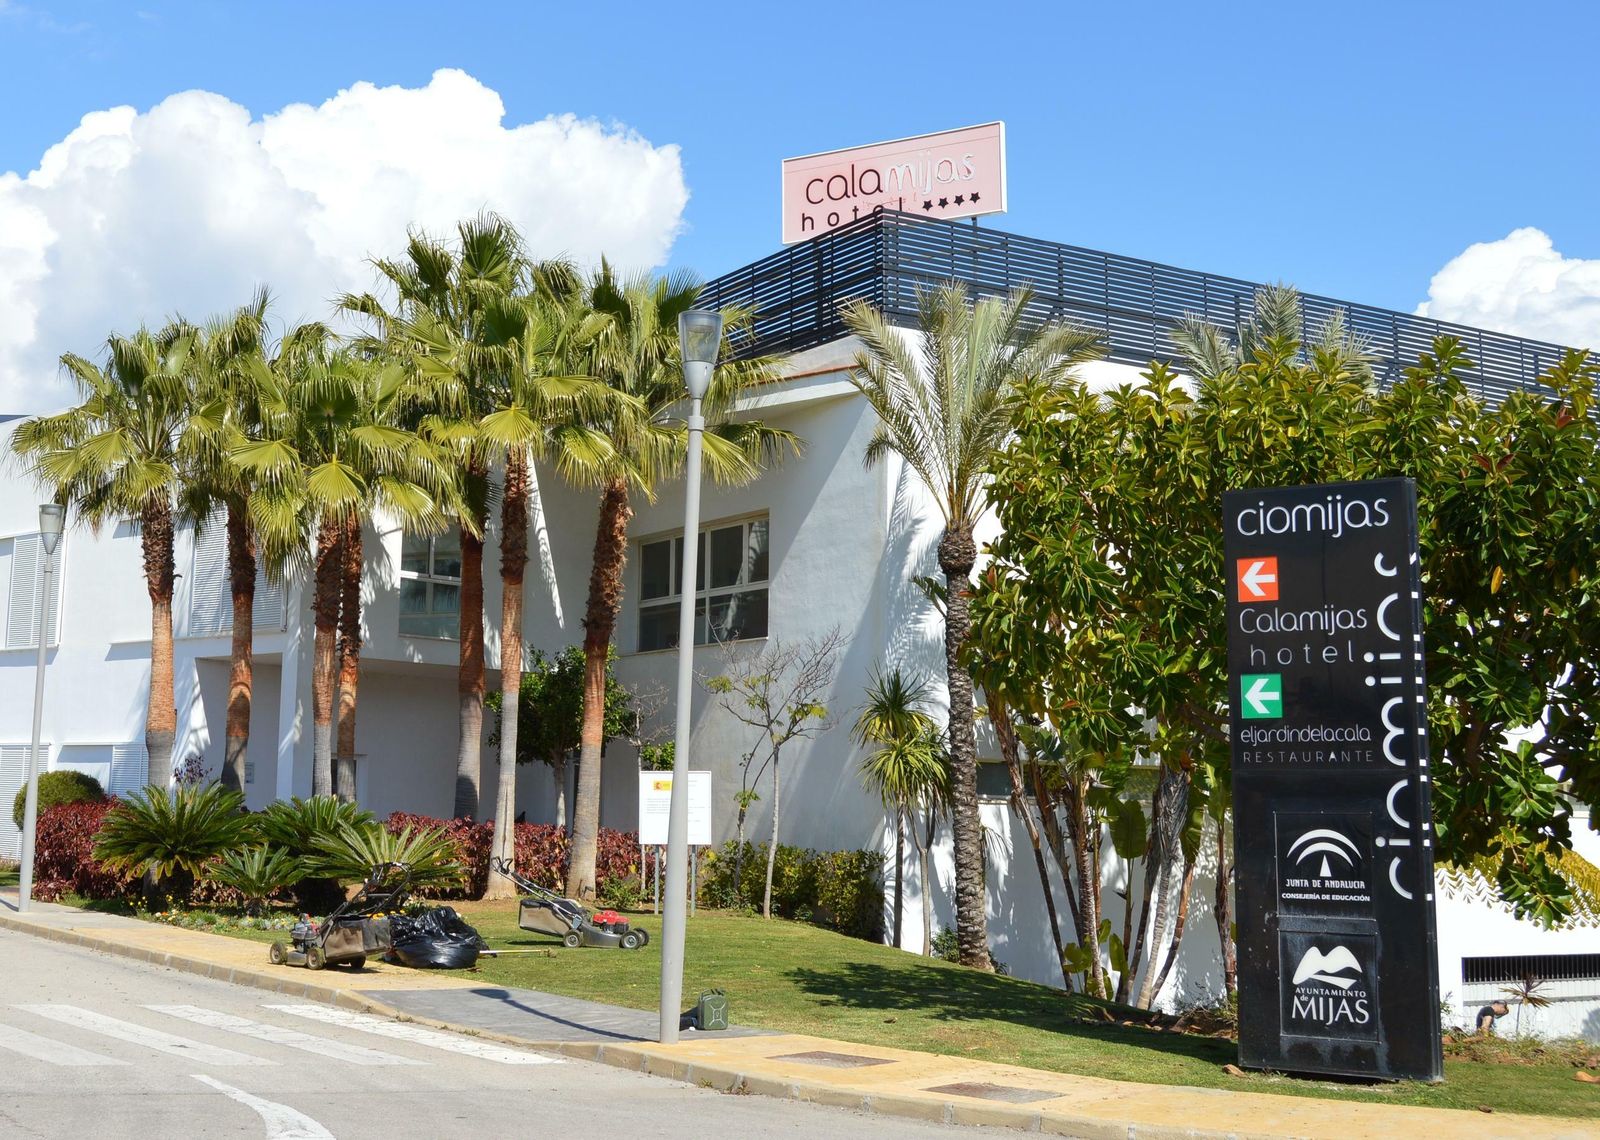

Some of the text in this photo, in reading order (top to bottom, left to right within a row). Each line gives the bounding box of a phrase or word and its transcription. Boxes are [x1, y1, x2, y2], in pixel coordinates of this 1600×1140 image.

[1236, 494, 1390, 538] ciomijas
[1239, 604, 1368, 636] Calamijas
[1249, 640, 1354, 667] hotel
[1240, 723, 1372, 747] eljardindelacala
[1243, 750, 1374, 763] RESTAURANTE
[1285, 879, 1309, 888] JUNTA
[1312, 879, 1322, 888] DE
[1331, 894, 1371, 902] EDUCACIÓN
[1295, 987, 1367, 998] AYUNTAMIENTO
[1291, 996, 1370, 1026] MIJAS
